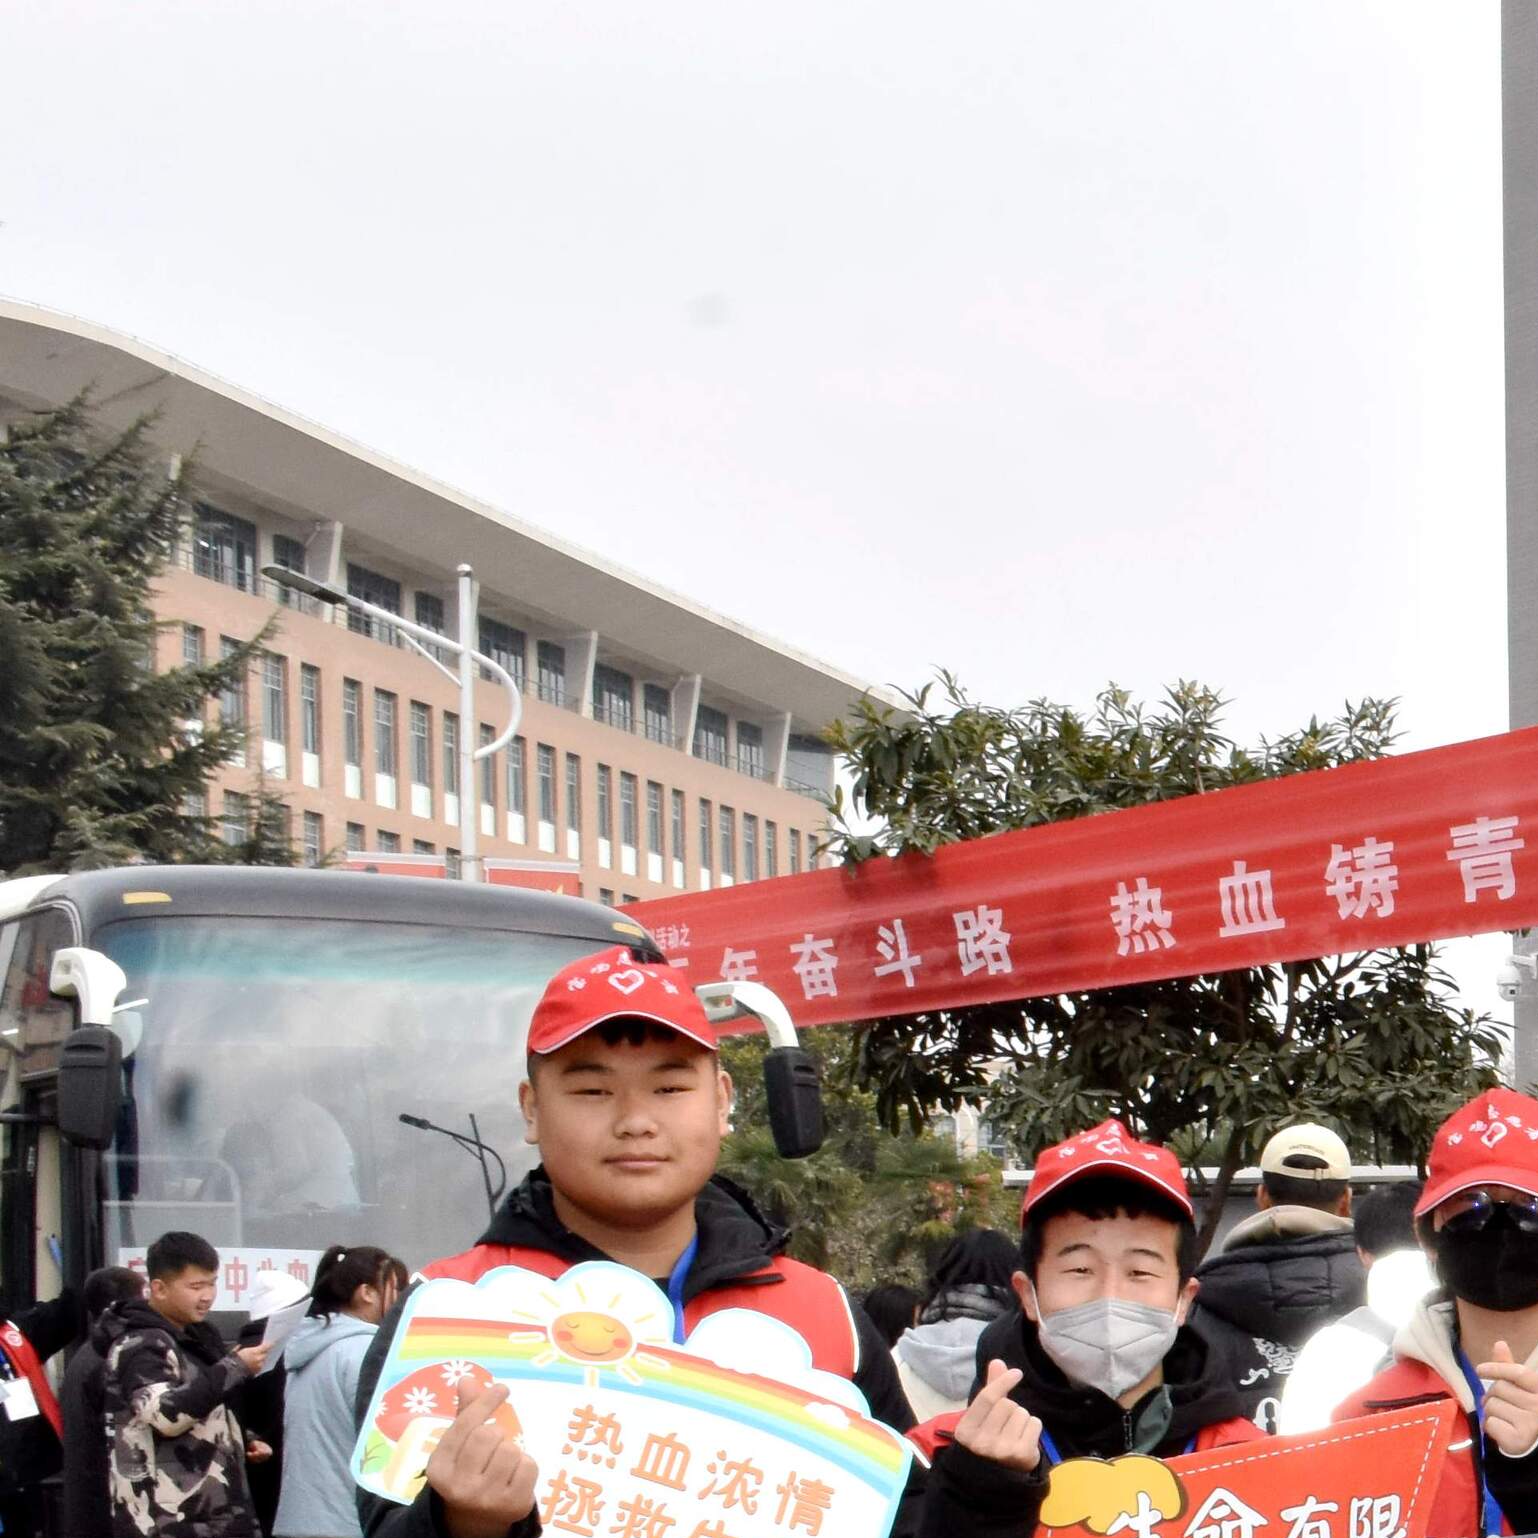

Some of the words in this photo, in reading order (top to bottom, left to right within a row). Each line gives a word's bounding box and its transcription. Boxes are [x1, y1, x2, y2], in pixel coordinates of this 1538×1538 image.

[668, 904, 1014, 1001] 年奋斗路
[561, 1404, 835, 1537] 热血浓情
